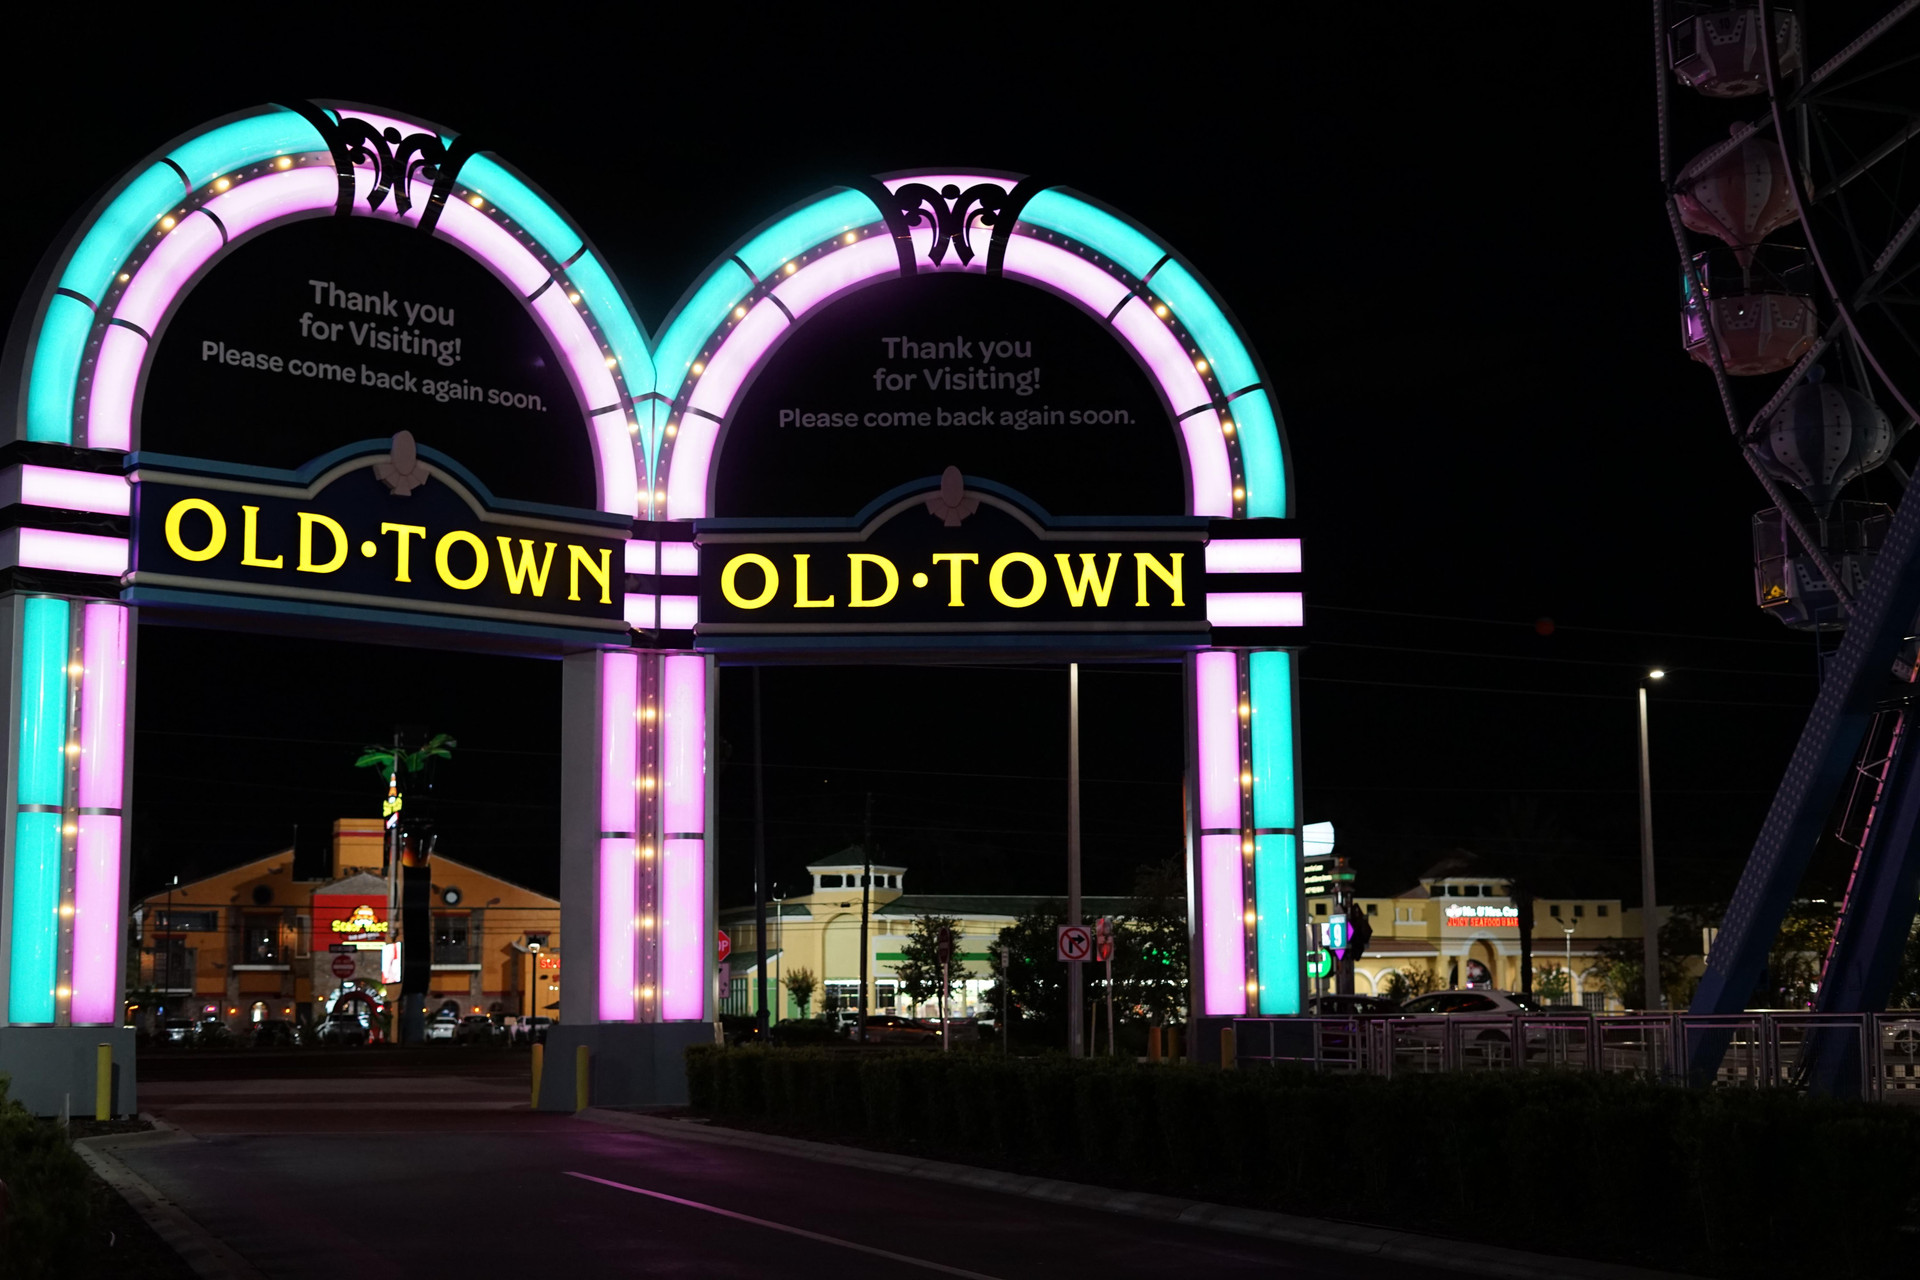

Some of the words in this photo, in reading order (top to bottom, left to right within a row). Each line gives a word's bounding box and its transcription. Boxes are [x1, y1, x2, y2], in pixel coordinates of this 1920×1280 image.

[309, 280, 397, 316] Thank
[404, 302, 454, 327] you
[300, 312, 344, 341] for
[349, 321, 462, 366] Visiting!
[882, 336, 973, 359] Thank
[979, 342, 1031, 364] you
[203, 341, 284, 372] Please
[289, 360, 355, 383] come
[362, 365, 418, 393] back
[423, 380, 483, 403] again
[488, 390, 547, 412] soon.
[873, 368, 917, 391] for
[924, 367, 1040, 396] Visiting!
[780, 409, 859, 428] Please
[864, 413, 931, 428] come
[938, 407, 995, 426] back
[1001, 409, 1065, 431] again
[1070, 411, 1137, 426] soon.
